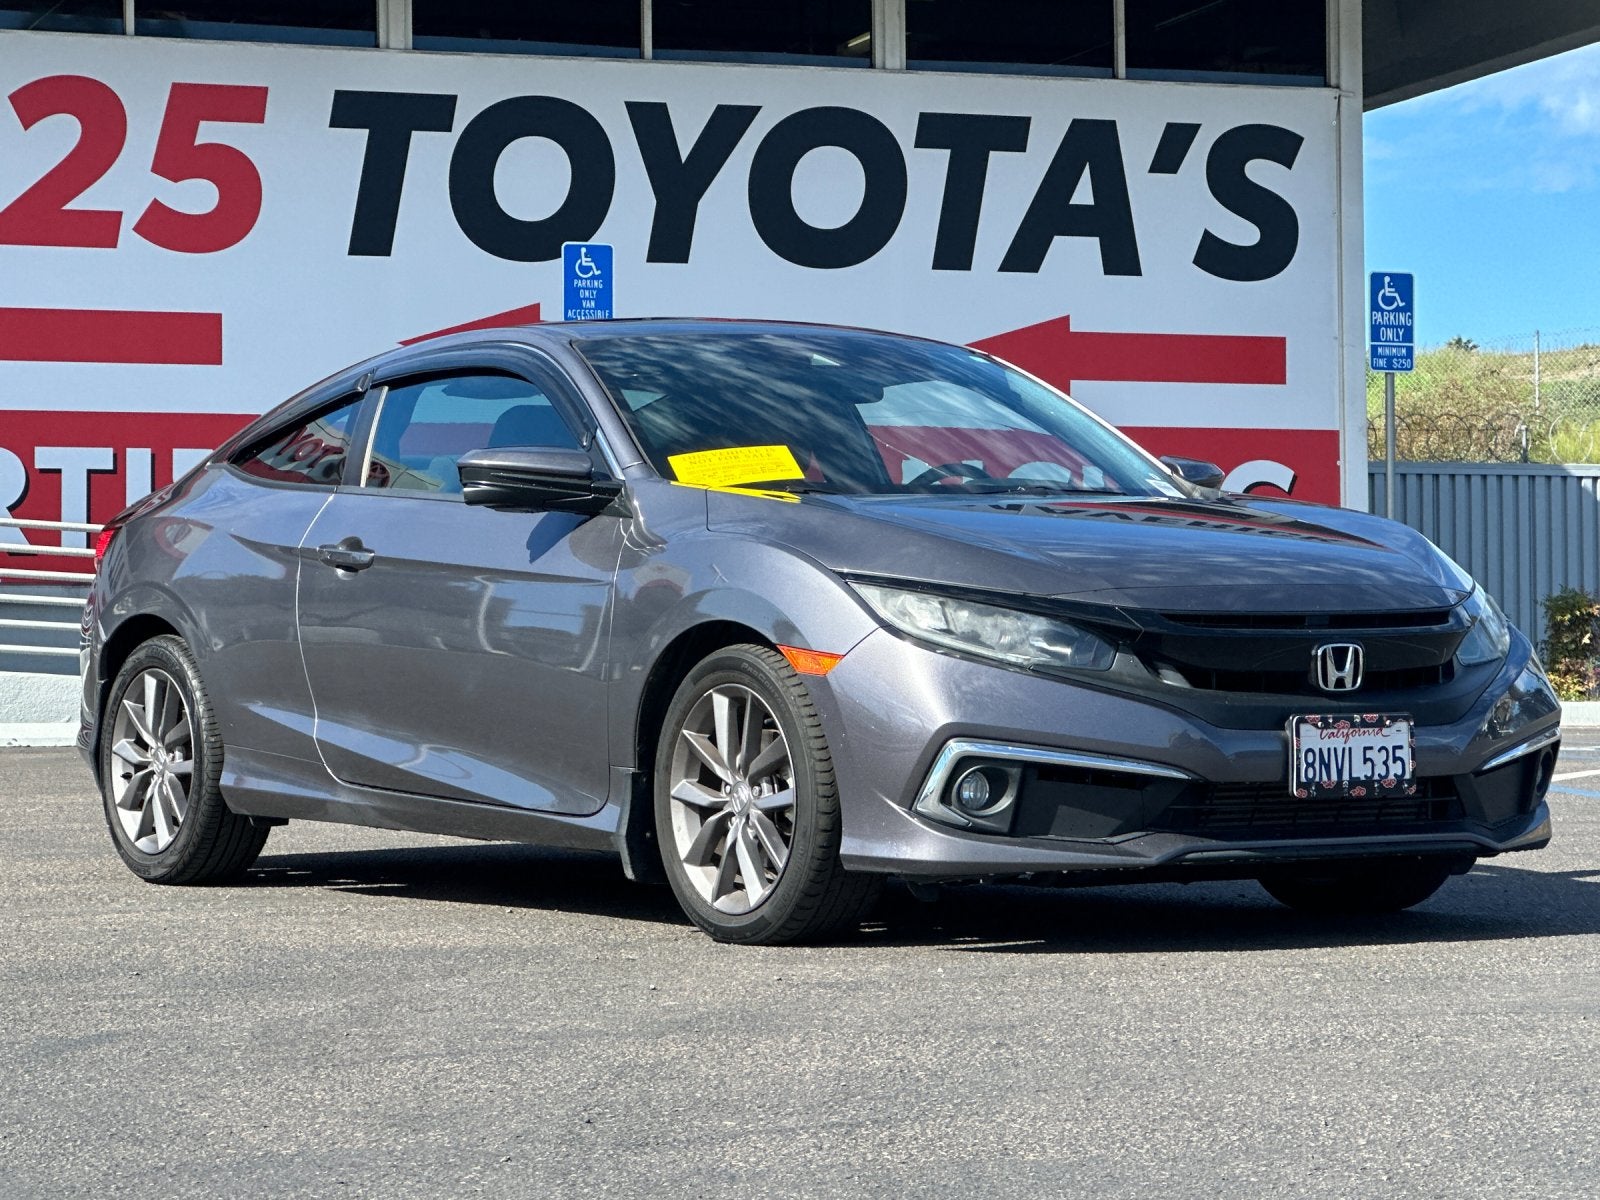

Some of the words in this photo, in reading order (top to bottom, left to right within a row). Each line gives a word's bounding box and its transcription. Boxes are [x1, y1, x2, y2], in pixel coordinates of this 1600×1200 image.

[329, 94, 1305, 282] TOYOTA'S
[573, 279, 603, 289] PARKING
[579, 289, 598, 299] ONLY
[581, 299, 596, 308] VAN
[567, 309, 610, 320] ACCESSIBLE
[1371, 311, 1412, 326] PARKING
[1380, 327, 1405, 342] ONLY
[1377, 346, 1407, 357] MINIMUM
[1373, 357, 1387, 368] FINE
[1392, 358, 1412, 369] $250
[1320, 726, 1391, 745] California
[1303, 744, 1406, 783] 8NVL535
